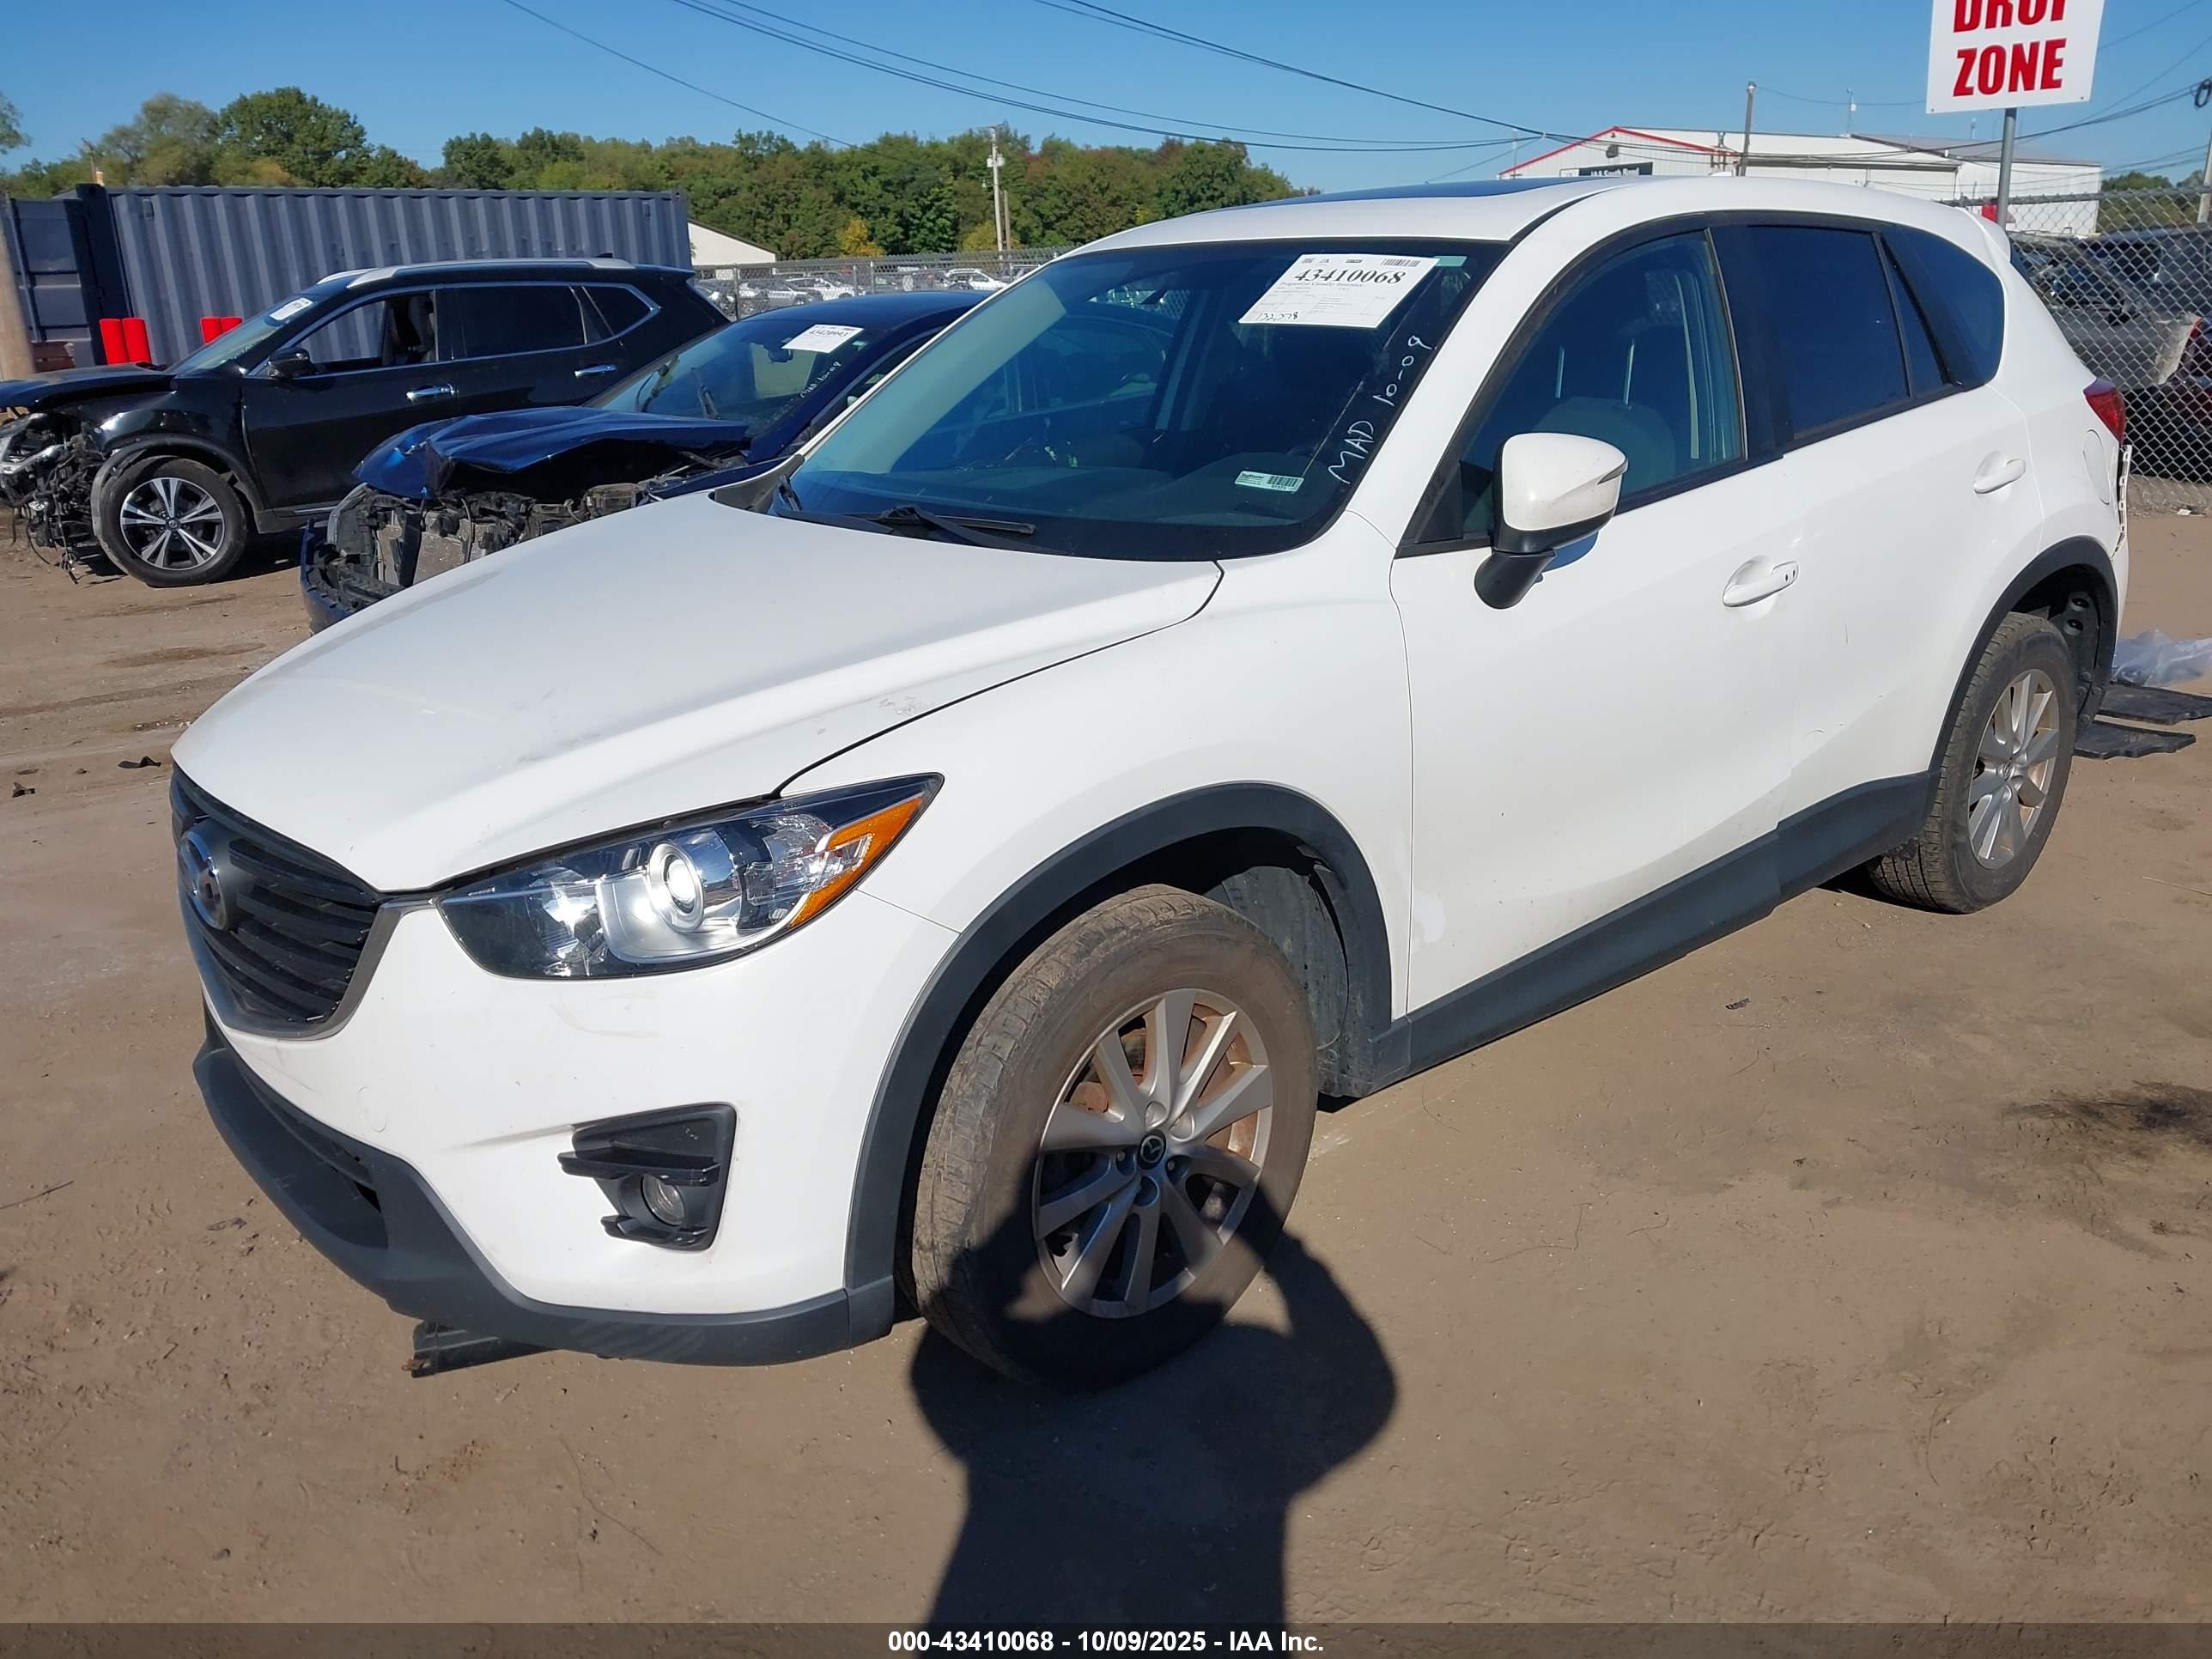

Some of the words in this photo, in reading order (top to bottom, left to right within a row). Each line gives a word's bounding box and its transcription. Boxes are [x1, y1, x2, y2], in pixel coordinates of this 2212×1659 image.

[1953, 38, 2067, 97] ZONE
[1295, 269, 1406, 284] 43410068
[1328, 420, 1375, 484] MAD
[1372, 335, 1435, 407] 10-09
